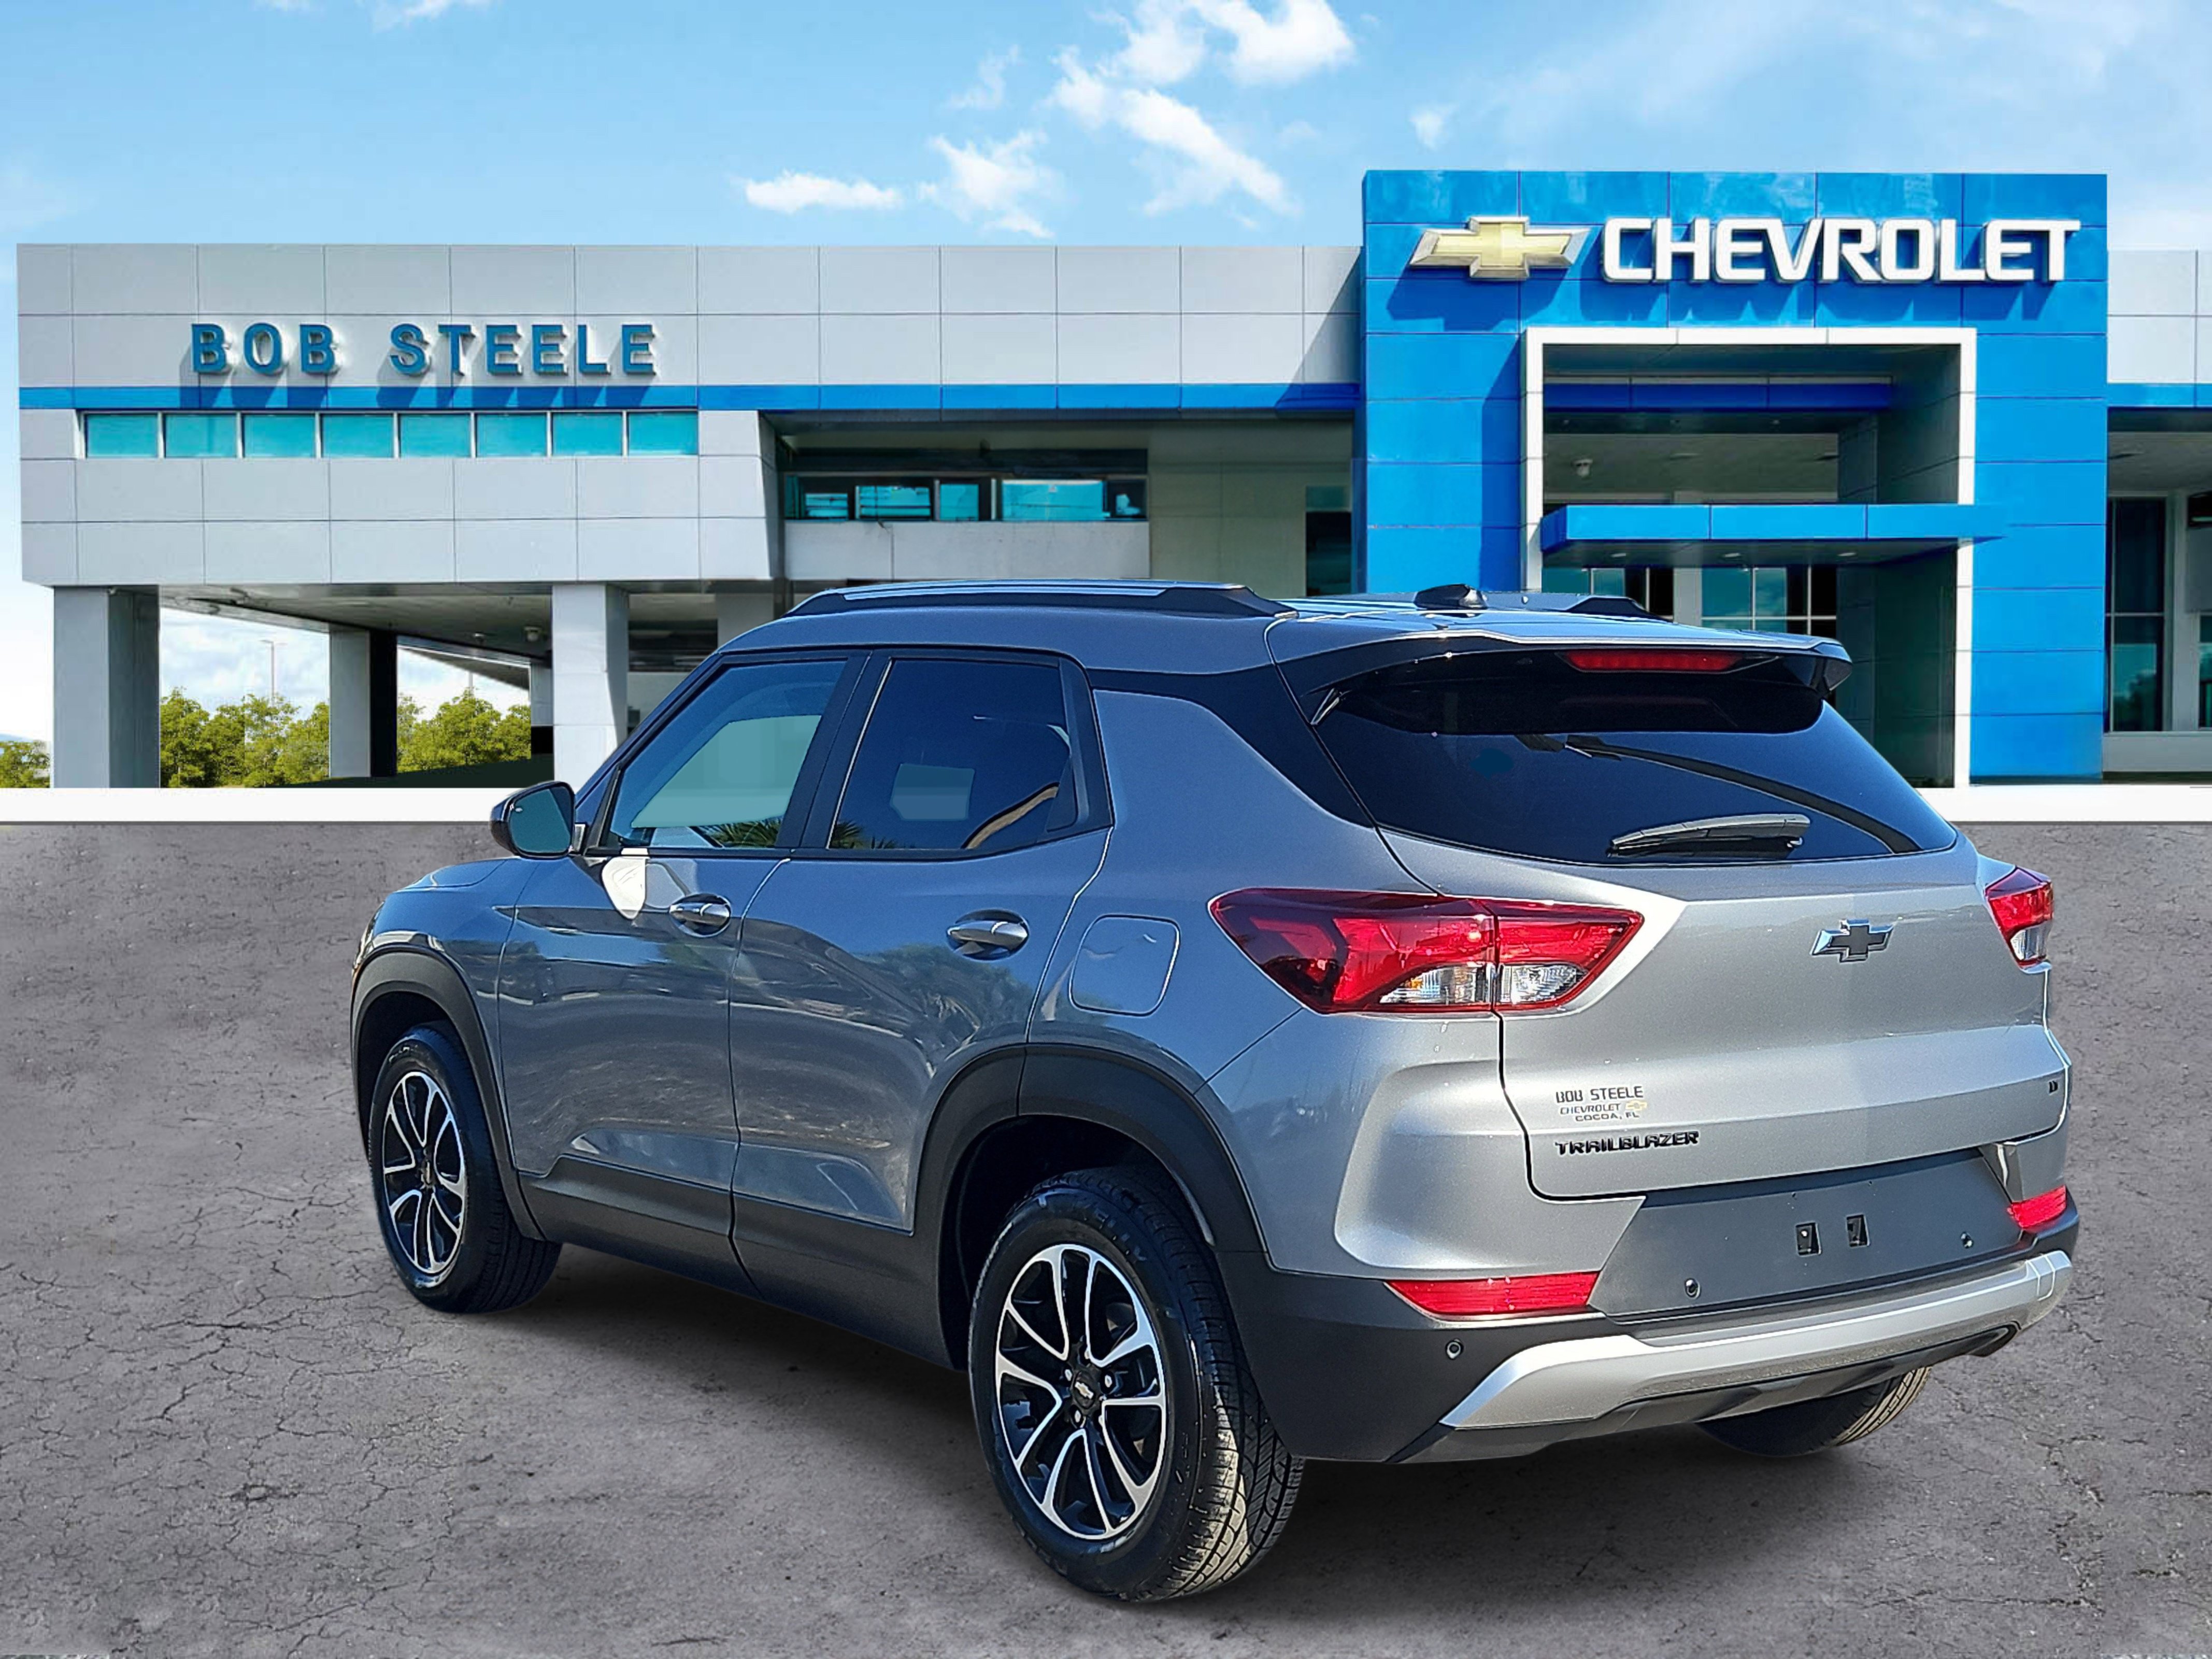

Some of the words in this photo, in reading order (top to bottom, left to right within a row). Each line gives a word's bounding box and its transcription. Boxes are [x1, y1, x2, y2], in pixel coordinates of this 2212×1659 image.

[1604, 217, 2081, 282] CHEVROLET
[192, 323, 337, 374] BOB
[390, 323, 656, 376] STEELE
[1555, 1089, 1583, 1103] BOB
[1590, 1086, 1644, 1101] STEELE
[1560, 1103, 1621, 1115] CHEVROLET
[1576, 1112, 1622, 1122] COCOA,
[1555, 1131, 1699, 1155] TRAILBLAZER
